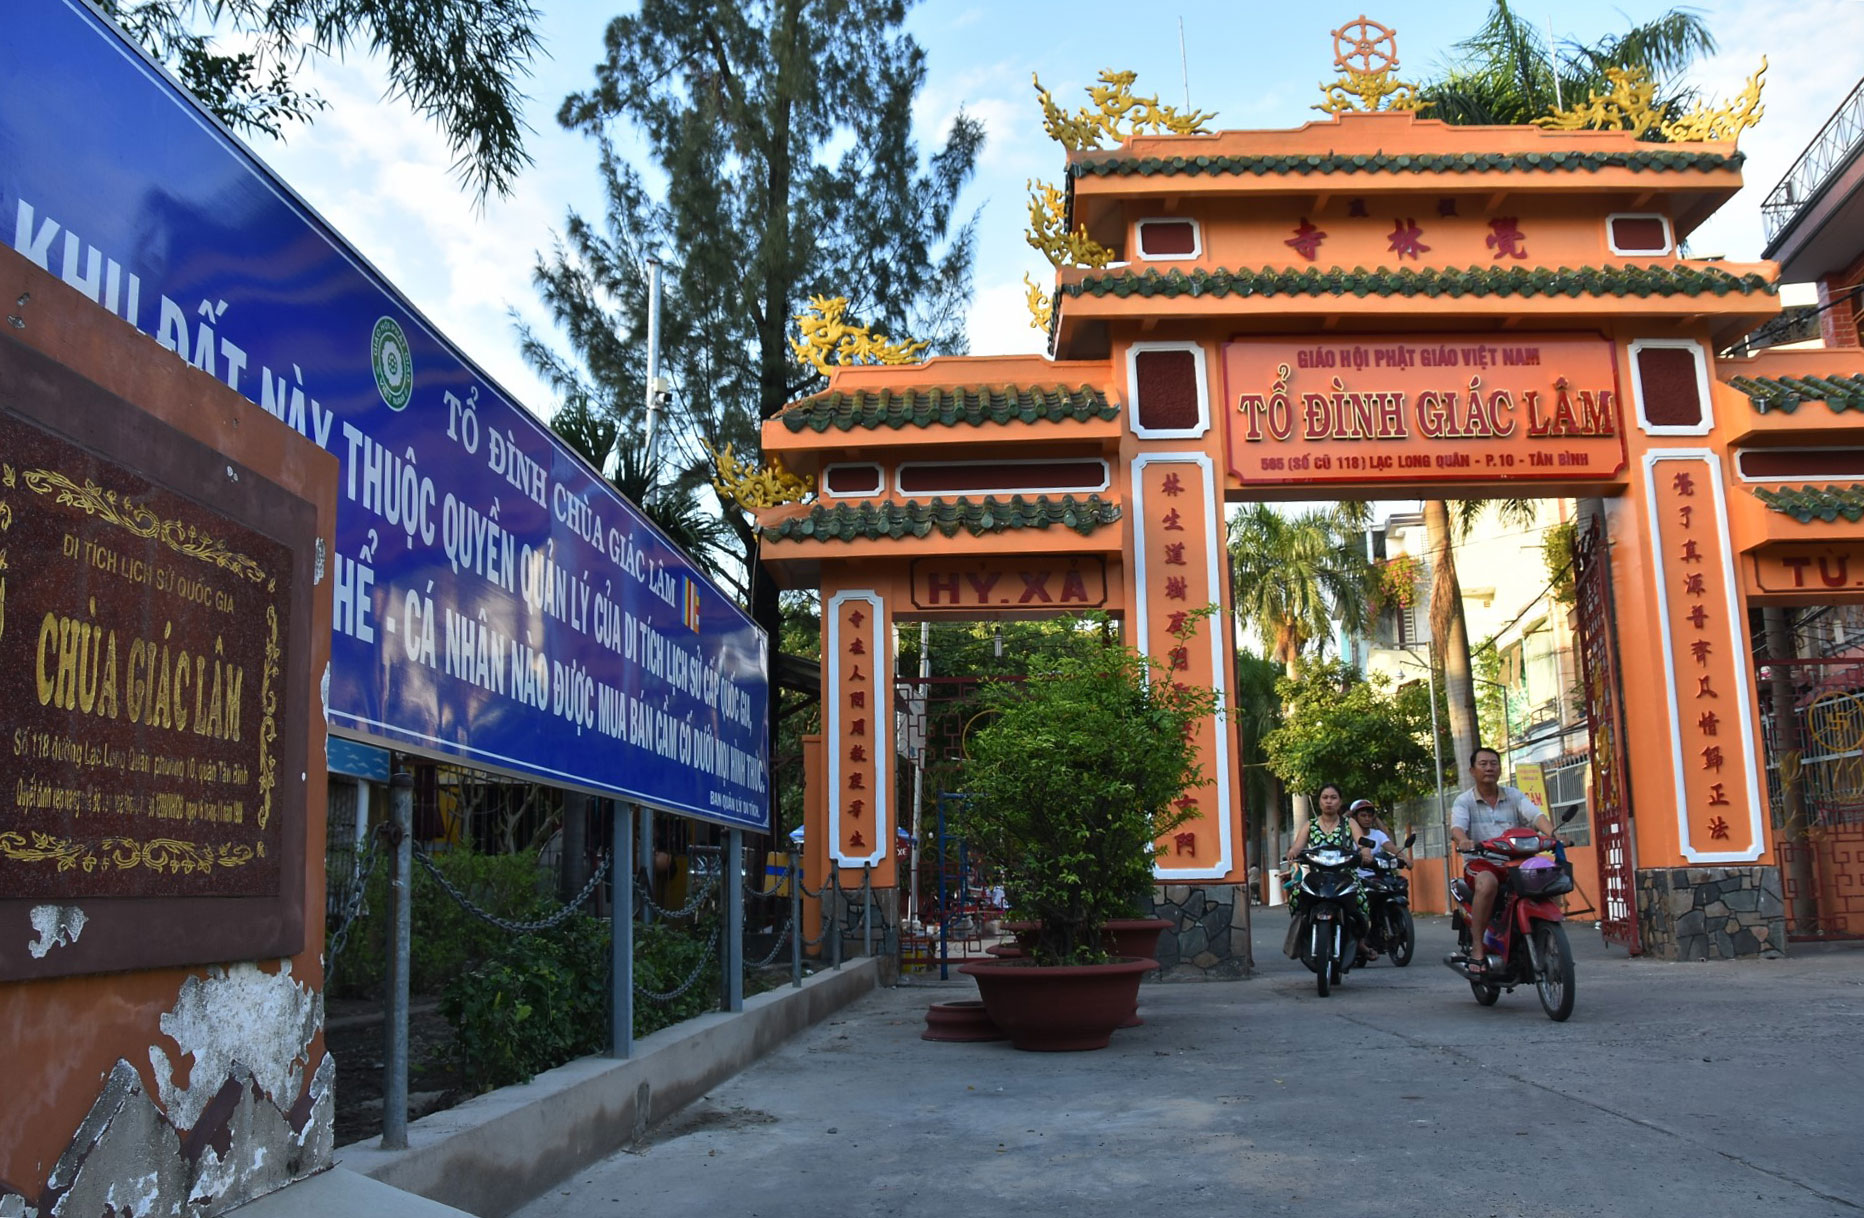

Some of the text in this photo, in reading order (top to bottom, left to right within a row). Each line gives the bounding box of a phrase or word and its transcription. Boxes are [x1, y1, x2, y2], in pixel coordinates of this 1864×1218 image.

[1298, 344, 1541, 371] GIÁO HỘI PHẬT GIÁO VIỆT NAM
[1238, 362, 1615, 441] TỔ ĐÌNH GIÁC LÂM
[444, 386, 677, 609] TỔ ĐÌNH CHÙA GIÁC LÂM
[1288, 453, 1311, 471] (SỐ
[1313, 454, 1332, 470] CŨ
[1369, 454, 1393, 471] LẠC
[1397, 454, 1431, 468] LONG
[1435, 451, 1470, 469] QUÂN
[1528, 450, 1554, 467] TÂN
[1558, 450, 1589, 466] BÌNH
[156, 294, 248, 392] ĐẤT
[260, 363, 334, 449] NÀY
[342, 420, 436, 550] THUỘC
[442, 492, 515, 593] QUYỀN
[520, 537, 567, 624] QUẢN
[570, 570, 590, 635] LÝ
[593, 579, 621, 654] CỦA
[624, 611, 637, 663] DI
[640, 615, 664, 679] TÍCH
[666, 640, 688, 696] LỊCH
[689, 645, 703, 700] SỬ
[703, 656, 720, 709] CẤP
[720, 671, 740, 722] QUỐC
[63, 533, 235, 614] DI TÍCH LỊCH SỬ QUỐC GIA
[36, 596, 243, 742] CHÙA GIÁC LÂM
[333, 527, 378, 644] HỂ
[404, 578, 436, 669] CÁ
[445, 607, 505, 696] NHÂN
[511, 629, 550, 712] NÀO
[553, 659, 595, 737] ĐƯỢC
[598, 681, 627, 744] MUA
[629, 689, 653, 752] BÁN
[655, 694, 678, 761] CẦM
[679, 709, 694, 766] CỐ
[693, 723, 715, 775] DƯỚI
[715, 738, 730, 788] MỌI
[730, 738, 746, 789] HÌNH
[13, 726, 31, 756] Số
[32, 731, 50, 759] 118
[51, 735, 83, 769] đường
[84, 740, 102, 771] Lạc
[709, 790, 722, 807] BAN
[722, 791, 736, 812] QUẢN
[735, 796, 743, 813] LÝ
